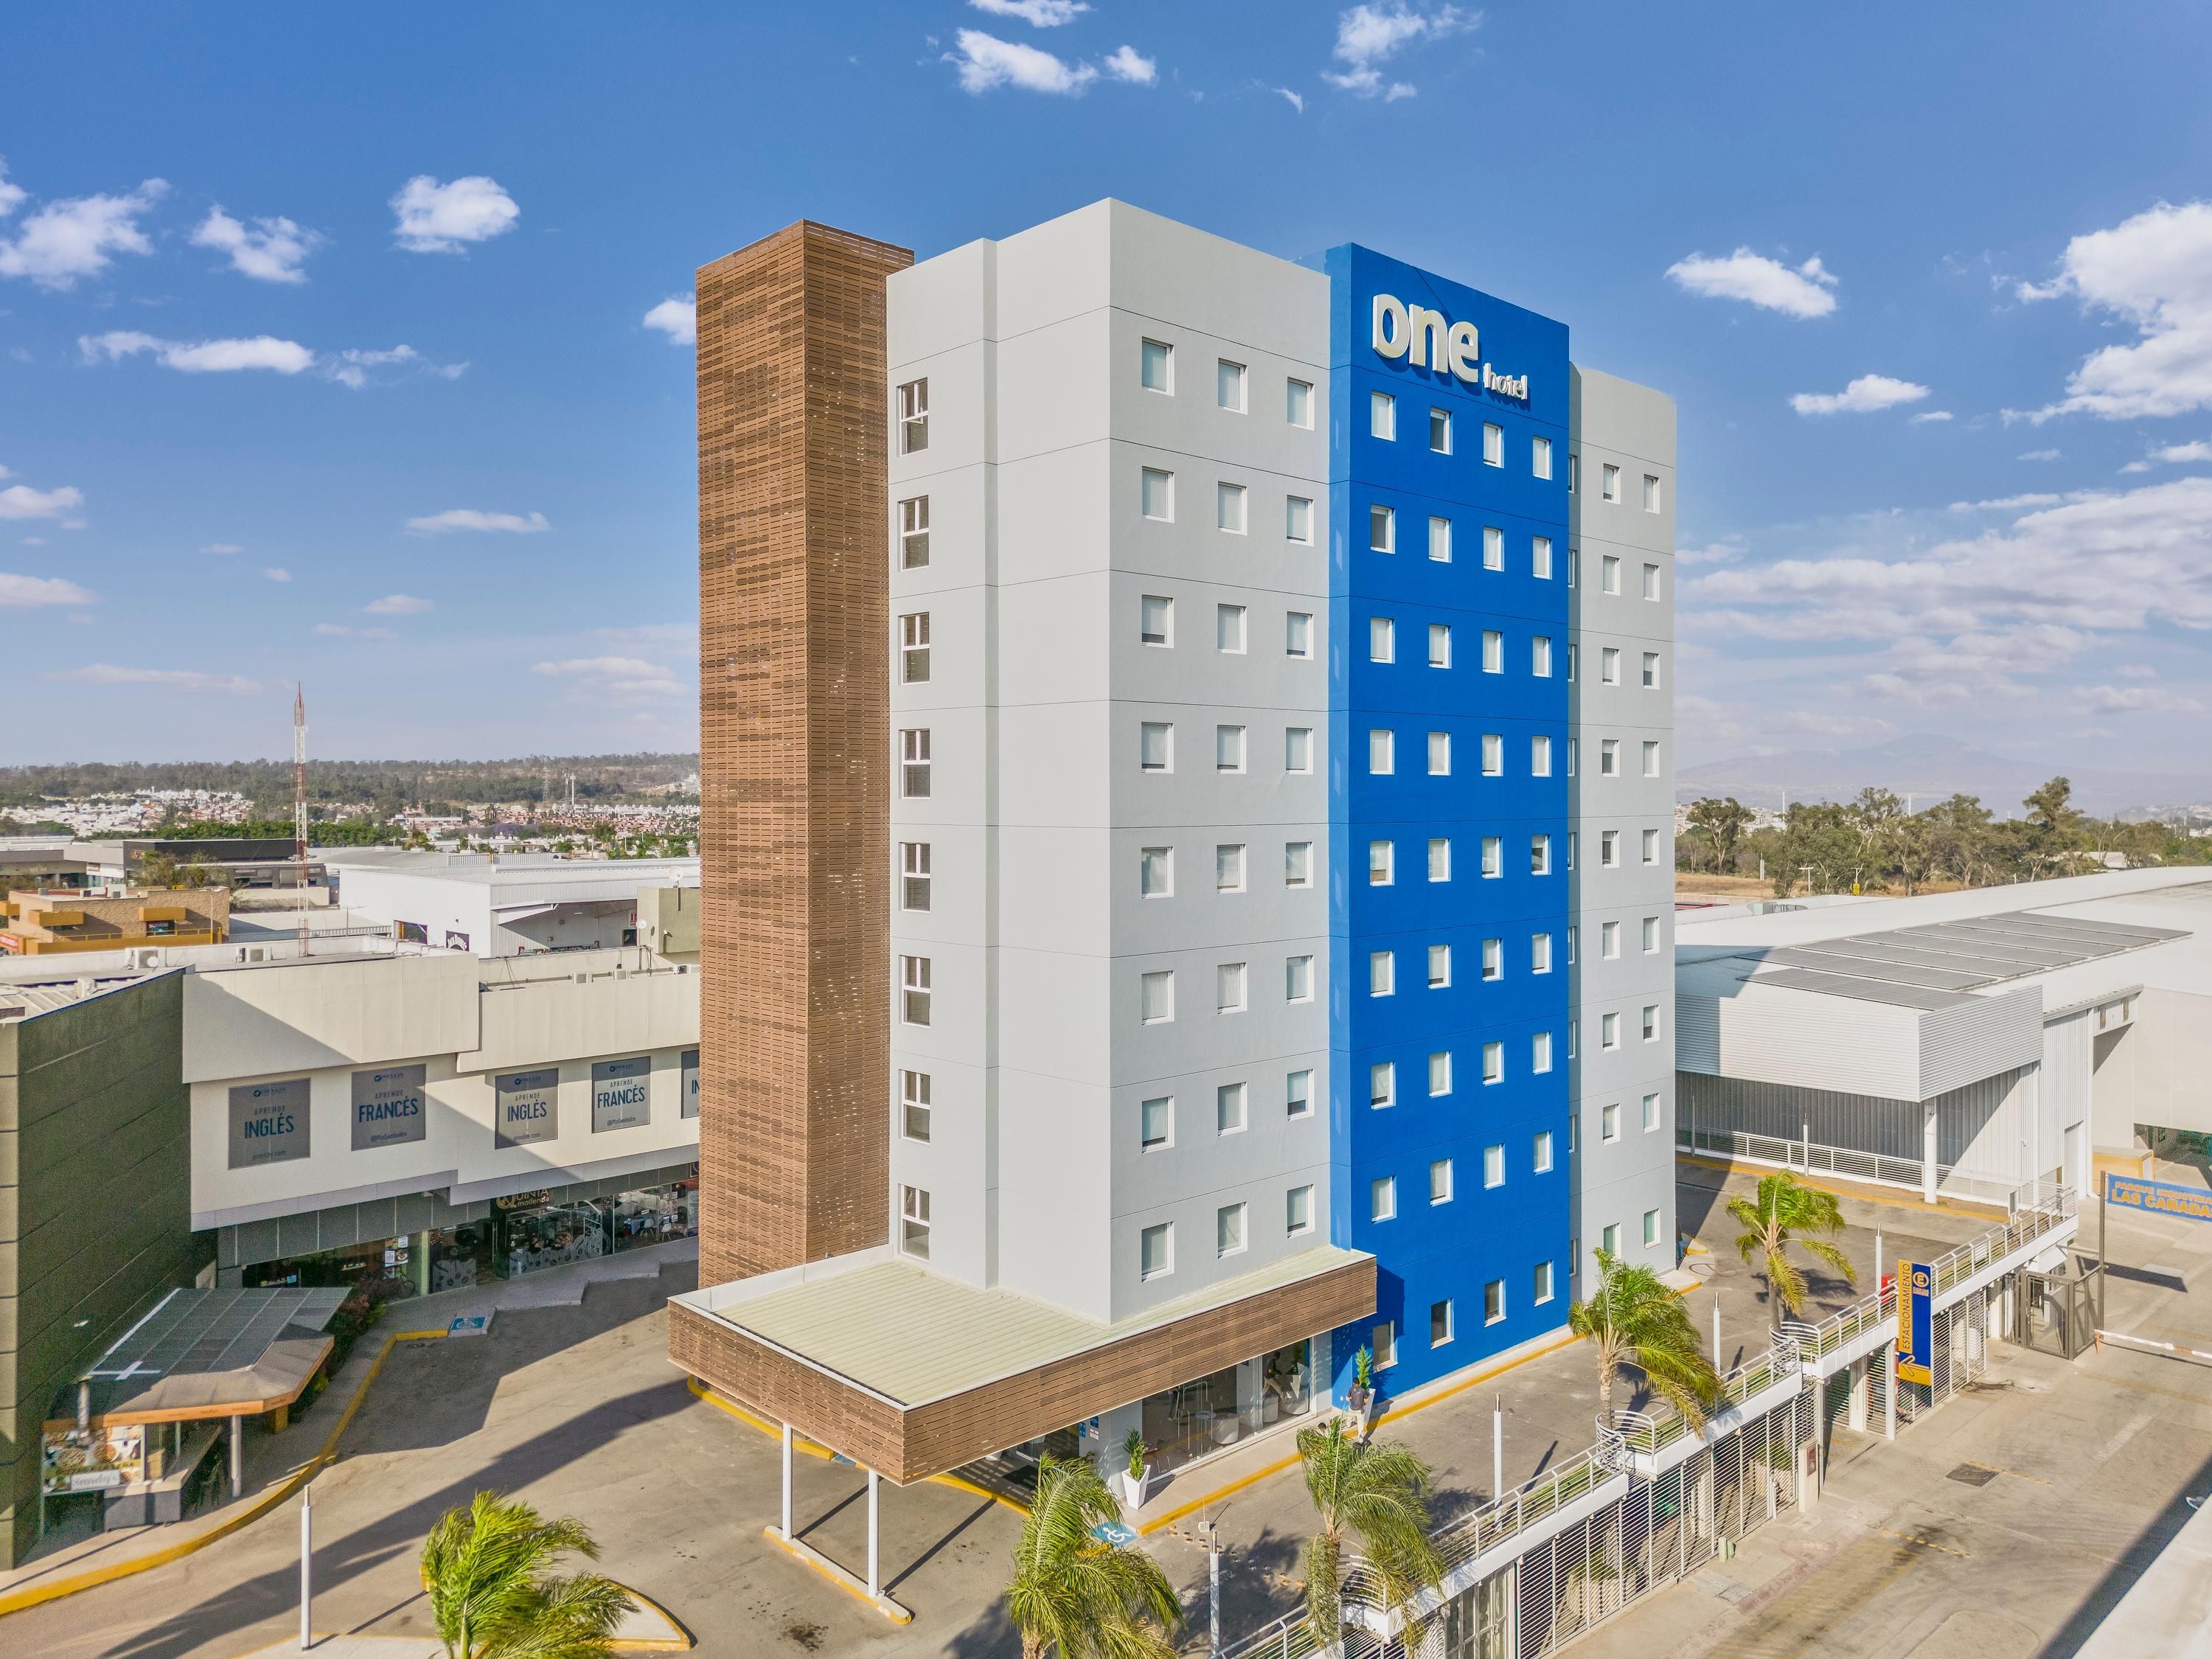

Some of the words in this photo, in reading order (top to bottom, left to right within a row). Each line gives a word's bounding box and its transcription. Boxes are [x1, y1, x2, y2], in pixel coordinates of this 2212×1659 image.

[1372, 293, 1478, 383] one
[1484, 362, 1528, 400] hotel
[374, 1090, 403, 1100] APRENDE
[610, 1078, 634, 1088] APRENDE
[515, 1092, 541, 1102] APRENDE
[597, 1084, 645, 1109] FRANCÉS
[358, 1096, 419, 1123] FRANCÉS
[507, 1099, 547, 1122] INGLÉS
[244, 1113, 295, 1139] INGLÉS
[2111, 1189, 2141, 1206] LAS
[2144, 1194, 2212, 1219] CAÑADA
[2156, 1188, 2212, 1205] INDUSTRIA
[1902, 1263, 1910, 1350] ESTACIONAMIENTO
